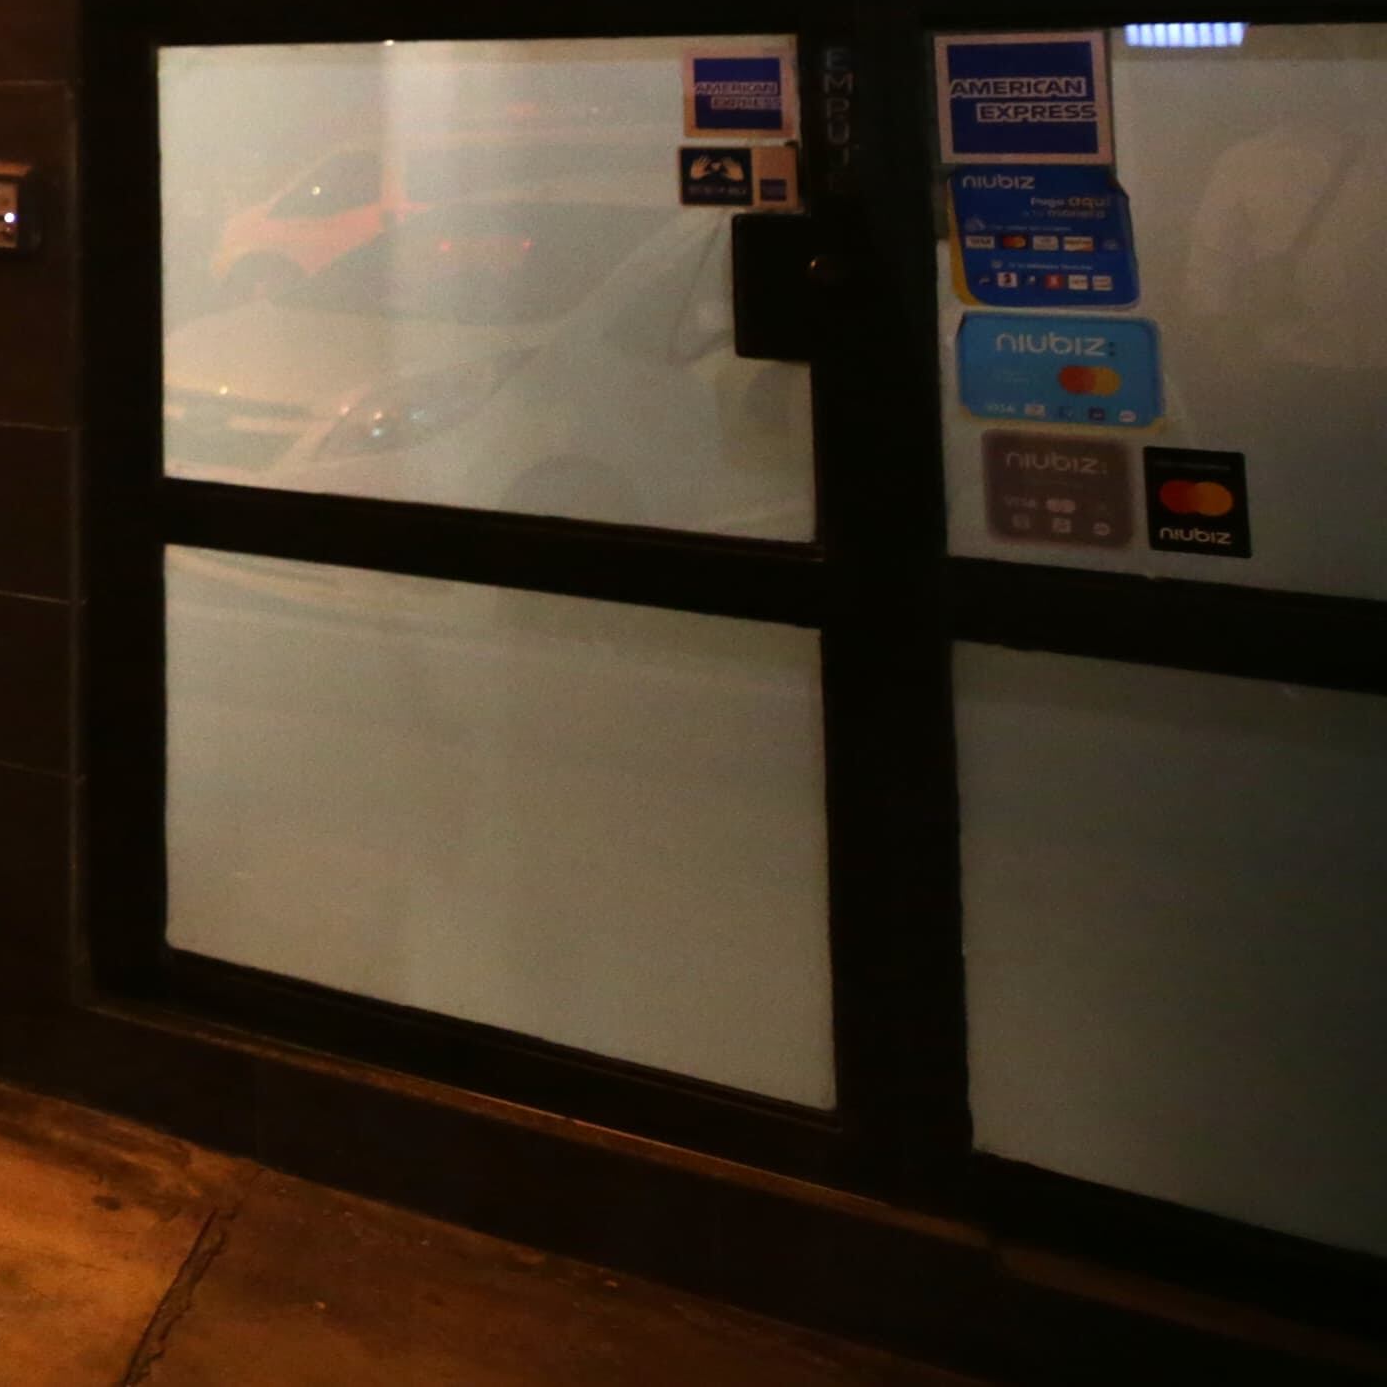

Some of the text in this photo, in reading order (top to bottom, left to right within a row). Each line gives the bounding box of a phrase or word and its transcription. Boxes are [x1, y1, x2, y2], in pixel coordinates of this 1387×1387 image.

[951, 78, 1083, 96] AMERICAN
[979, 104, 1097, 120] EXPRESS
[962, 173, 1036, 190] niubiz
[1159, 525, 1233, 545] niubiz
